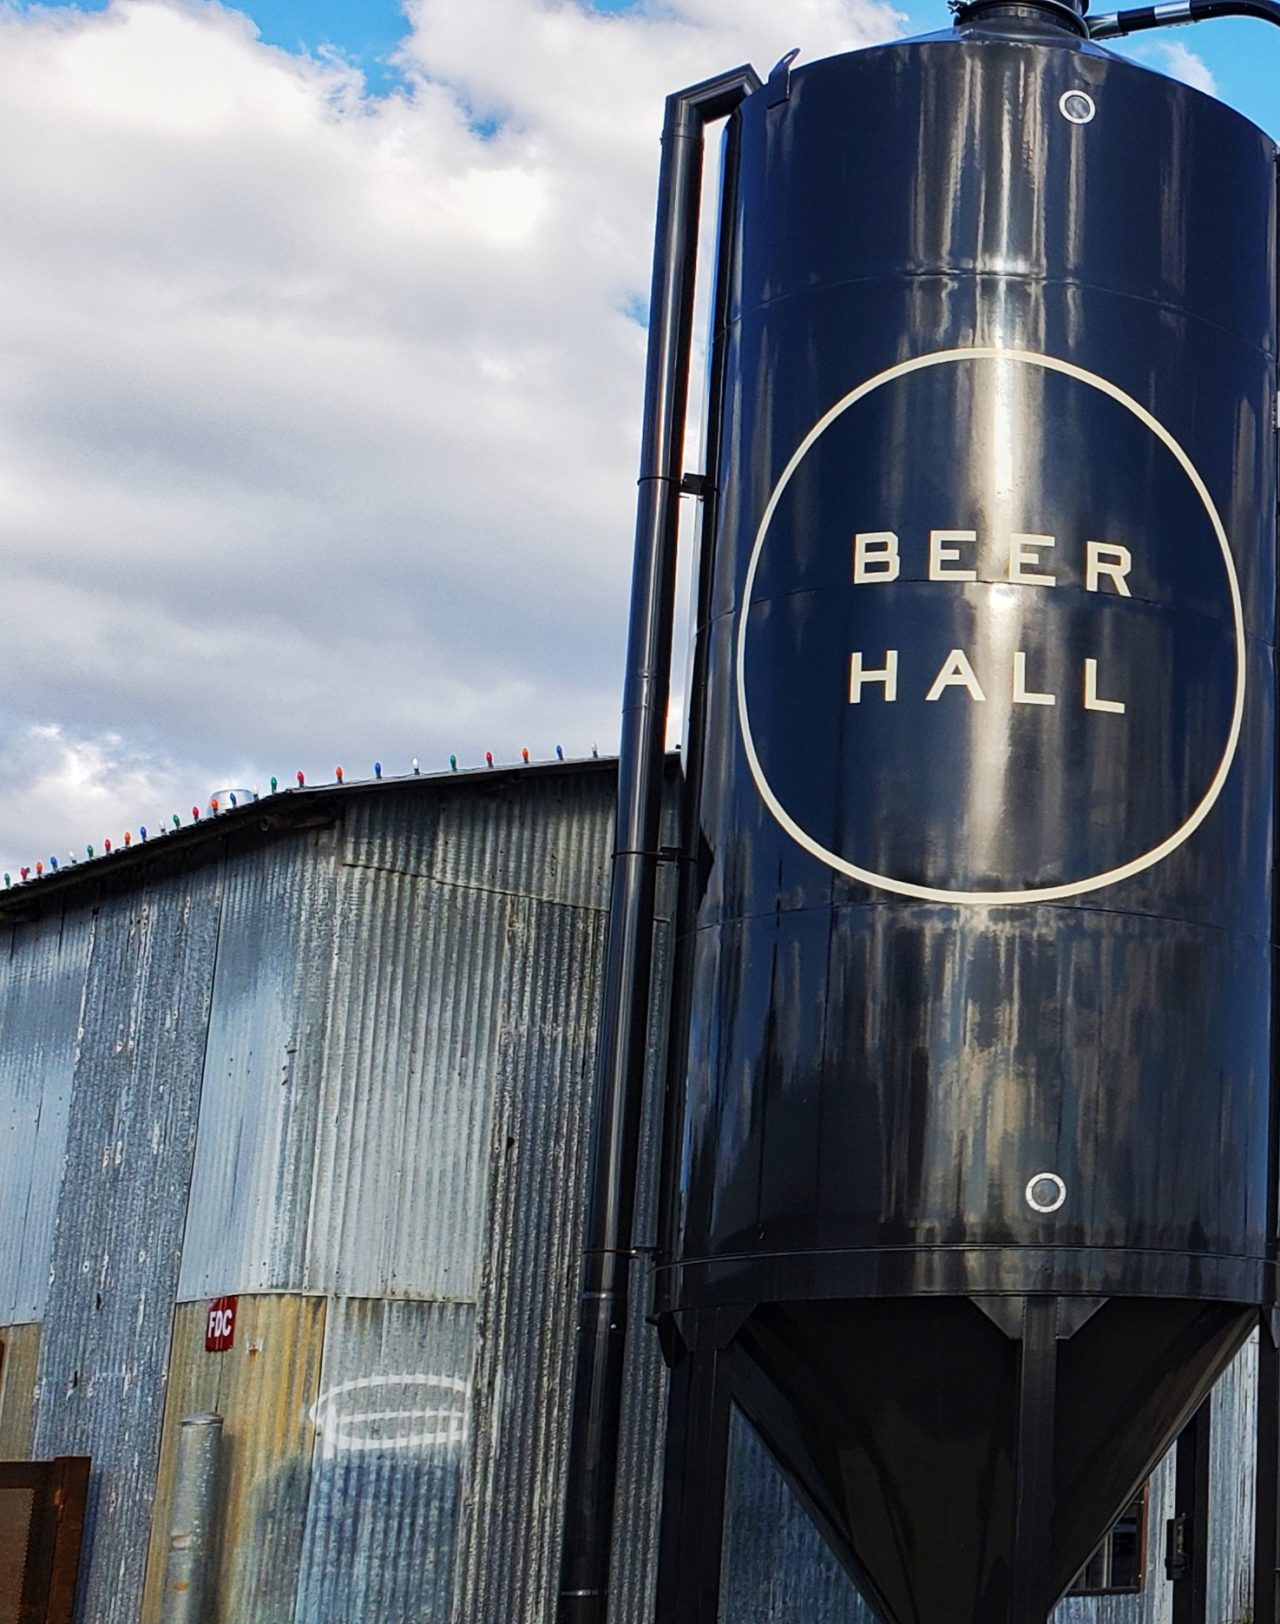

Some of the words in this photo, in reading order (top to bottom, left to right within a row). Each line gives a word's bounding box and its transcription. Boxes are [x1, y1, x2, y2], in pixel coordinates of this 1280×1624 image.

[853, 529, 1132, 597] BEER
[849, 648, 1126, 714] HALL
[207, 1309, 233, 1338] FDC
